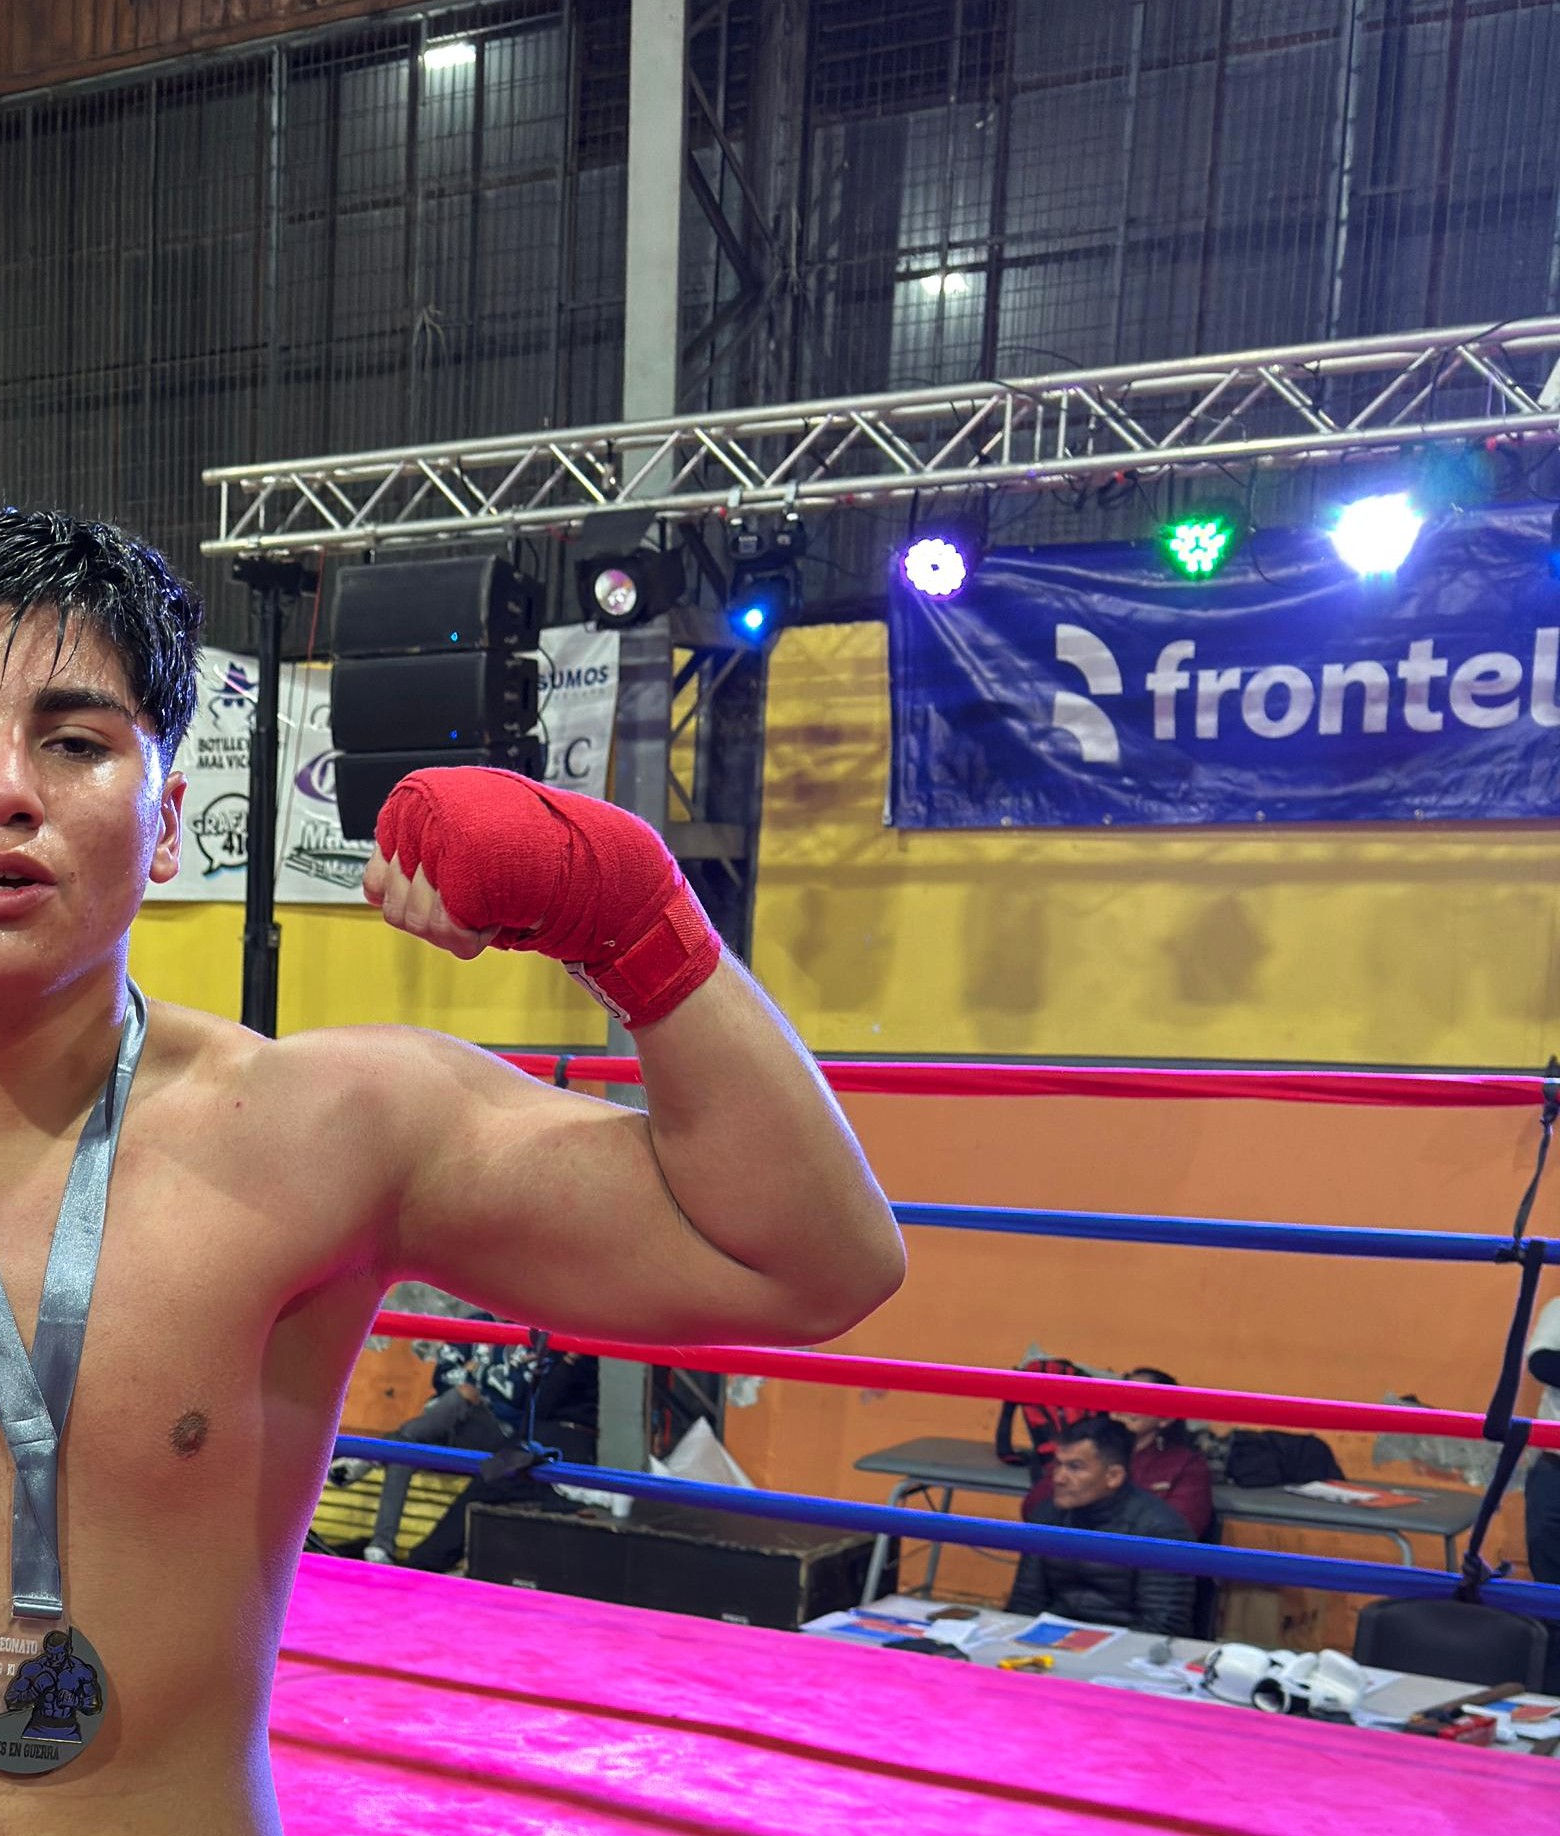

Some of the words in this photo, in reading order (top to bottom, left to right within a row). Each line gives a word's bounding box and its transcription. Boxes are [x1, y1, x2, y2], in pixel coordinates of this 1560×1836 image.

[538, 665, 610, 690] SUMOS
[1145, 626, 1560, 740] frontel
[197, 737, 251, 753] BOTILLE
[8, 1741, 22, 1757] EN
[23, 1743, 60, 1761] GUERRA
